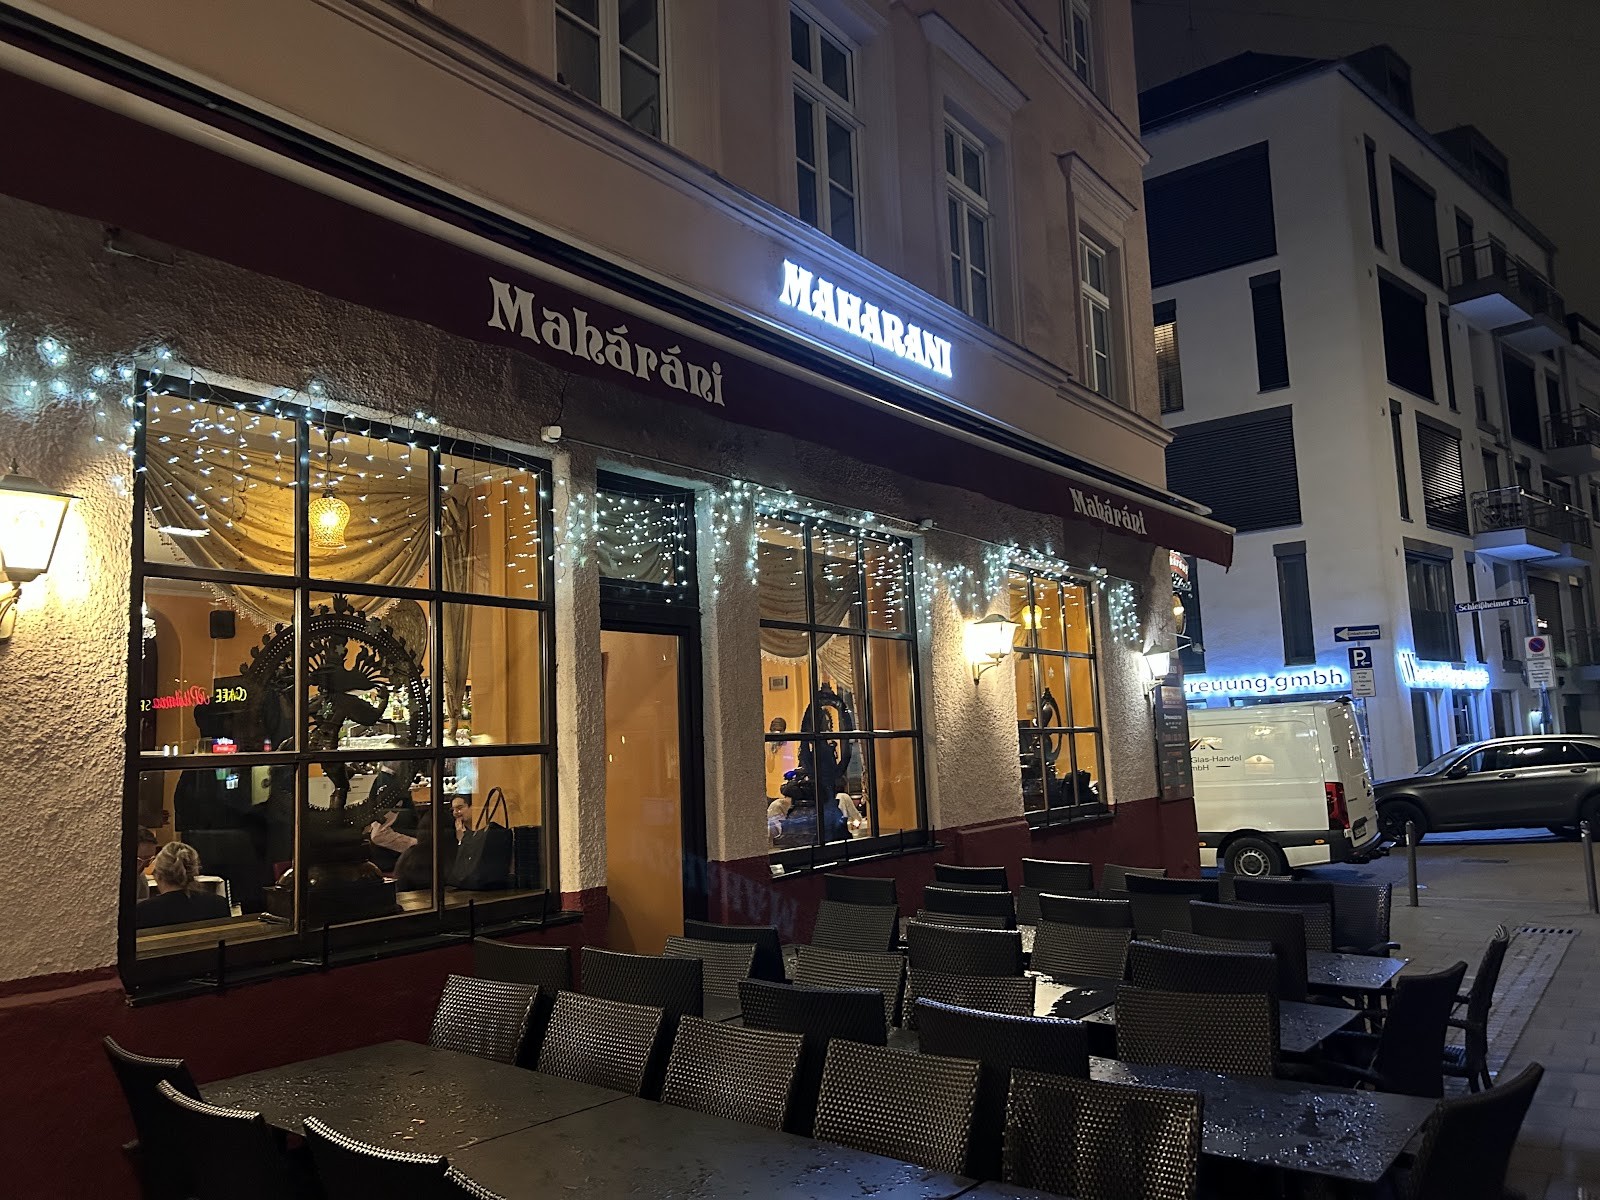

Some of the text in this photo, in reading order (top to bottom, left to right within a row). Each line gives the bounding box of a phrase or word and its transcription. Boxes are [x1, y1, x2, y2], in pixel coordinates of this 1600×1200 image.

[779, 258, 953, 379] MAHARANI
[487, 276, 726, 407] Maháráni
[1069, 487, 1148, 535] Maháráni
[1458, 601, 1511, 611] Schleißheimer
[1353, 650, 1367, 667] P
[1275, 669, 1344, 691] gmbh
[1190, 755, 1242, 763] Glas-Handel
[1191, 764, 1210, 772] mbH
